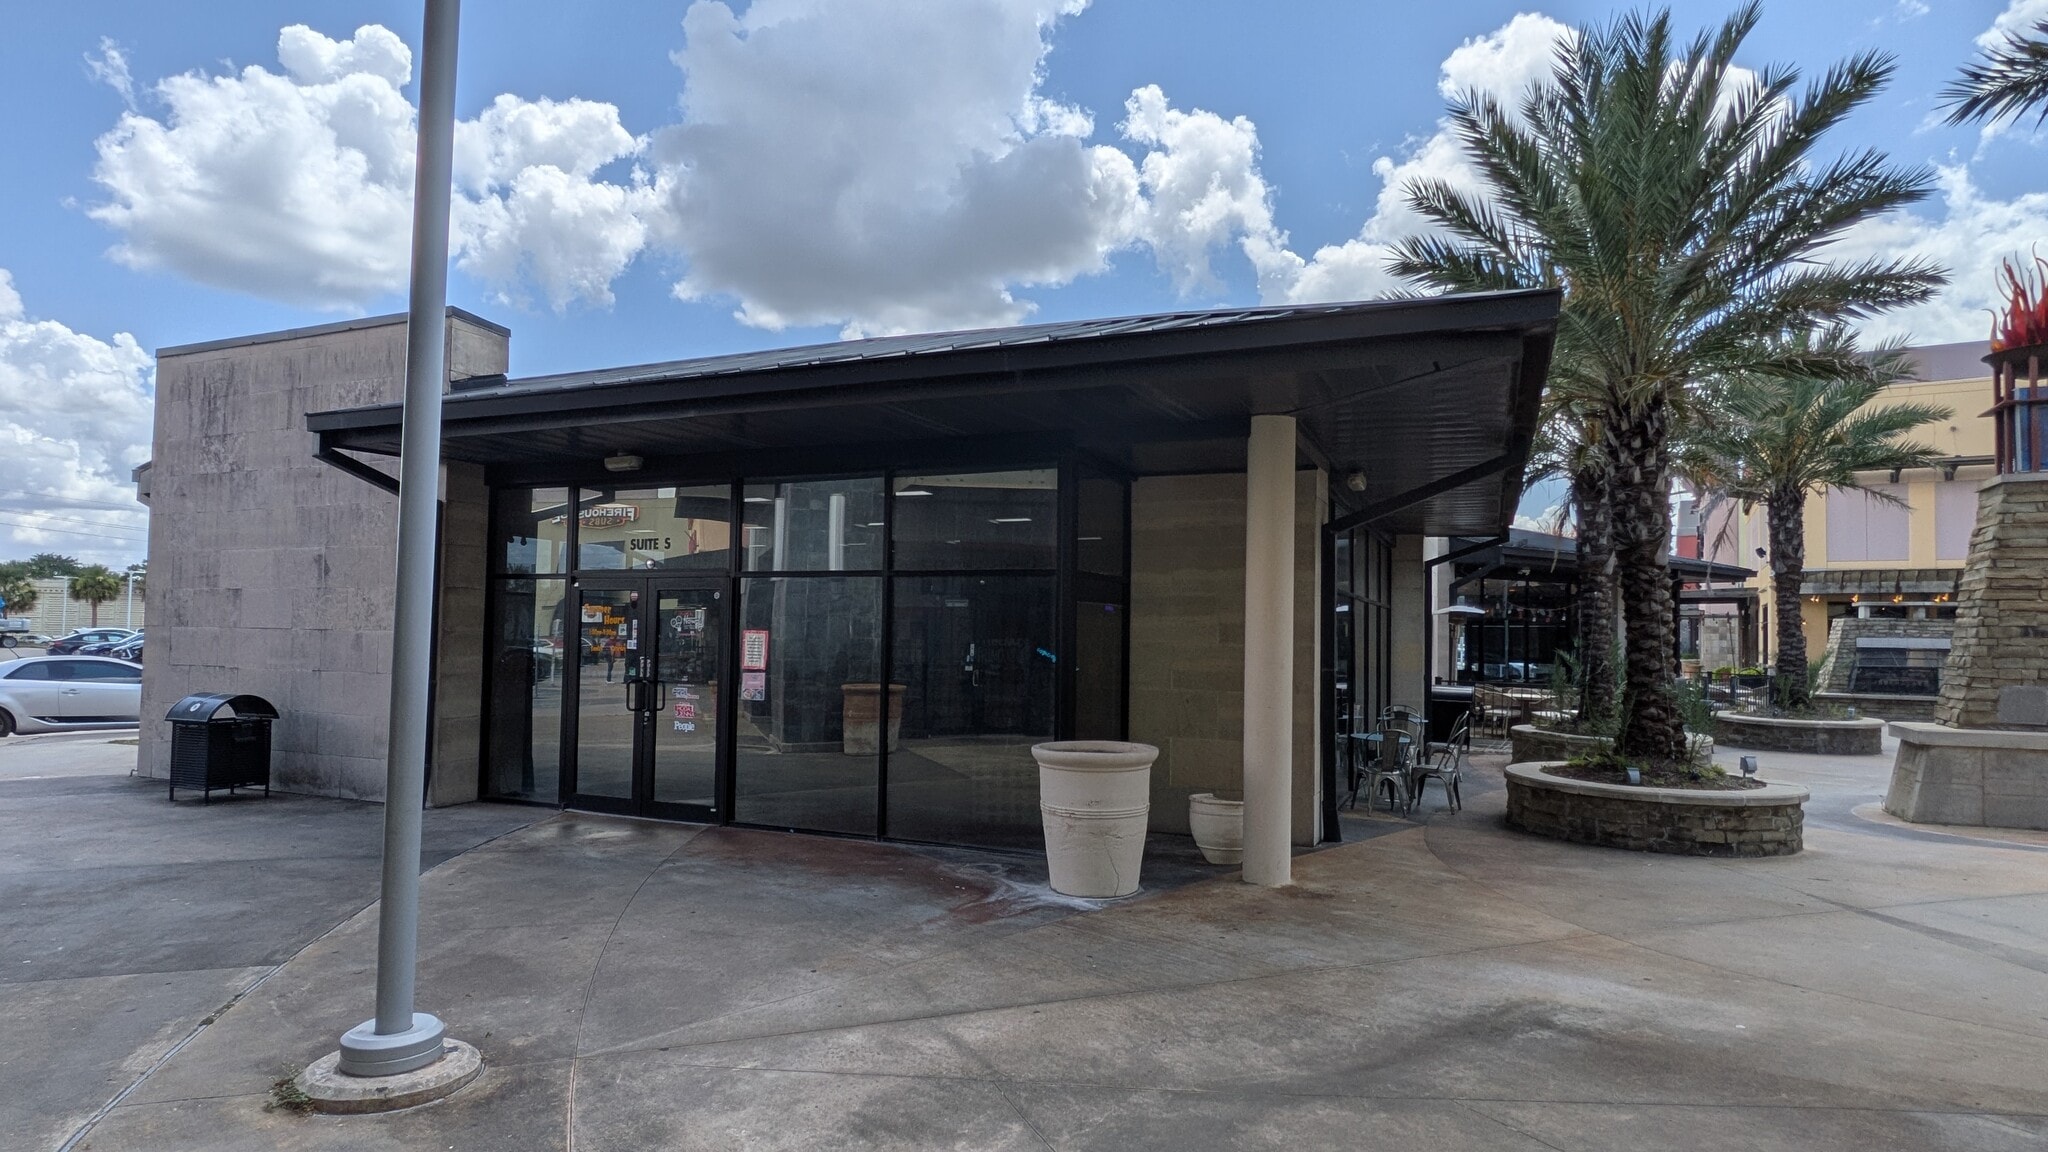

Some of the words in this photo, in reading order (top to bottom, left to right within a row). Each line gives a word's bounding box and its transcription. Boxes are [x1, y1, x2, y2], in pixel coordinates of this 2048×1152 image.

[630, 538, 659, 550] SUITE
[664, 537, 671, 549] S
[604, 615, 625, 625] Hours
[674, 720, 696, 732] People
